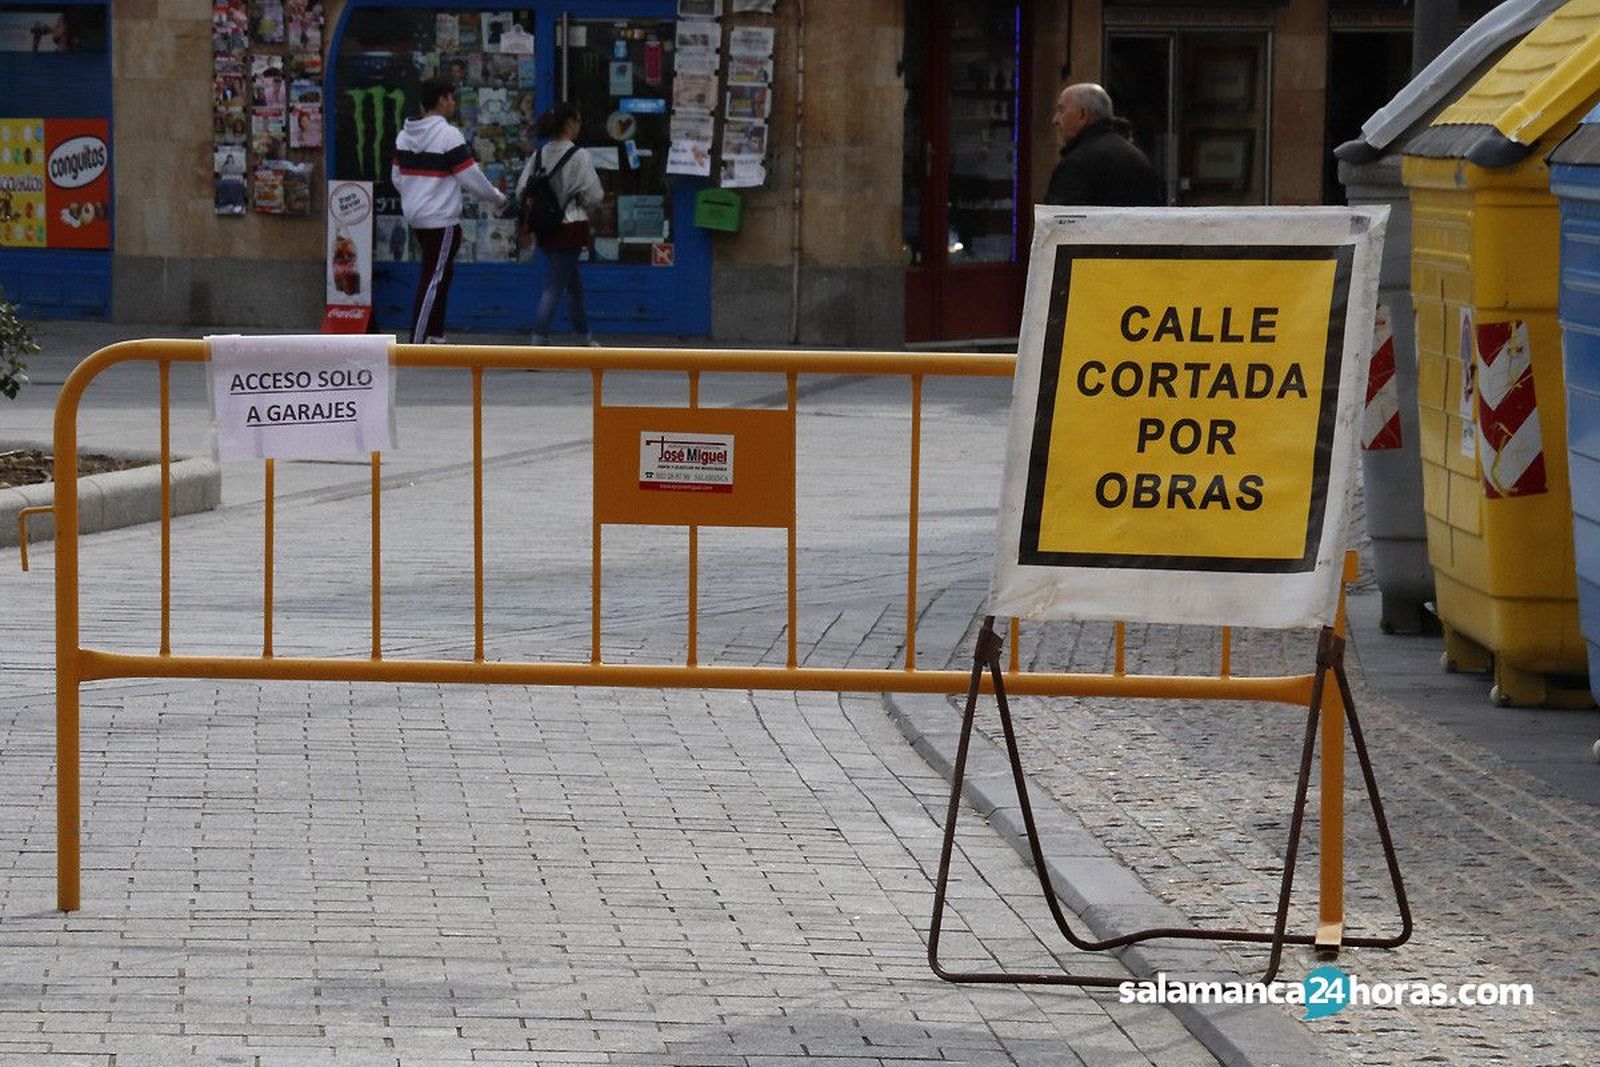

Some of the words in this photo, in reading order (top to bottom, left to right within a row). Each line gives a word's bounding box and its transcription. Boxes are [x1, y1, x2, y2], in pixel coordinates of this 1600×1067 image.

[51, 145, 105, 180] conguitos
[1120, 305, 1279, 343] CALLE
[230, 371, 312, 392] ACCESO
[318, 369, 373, 388] SOLO
[1076, 360, 1308, 399] CORTADA
[246, 406, 261, 423] A
[267, 401, 357, 422] GARAJES
[658, 436, 685, 462] José
[687, 447, 728, 465] Miguel
[1136, 418, 1237, 455] POR
[1095, 472, 1264, 511] OBRAS
